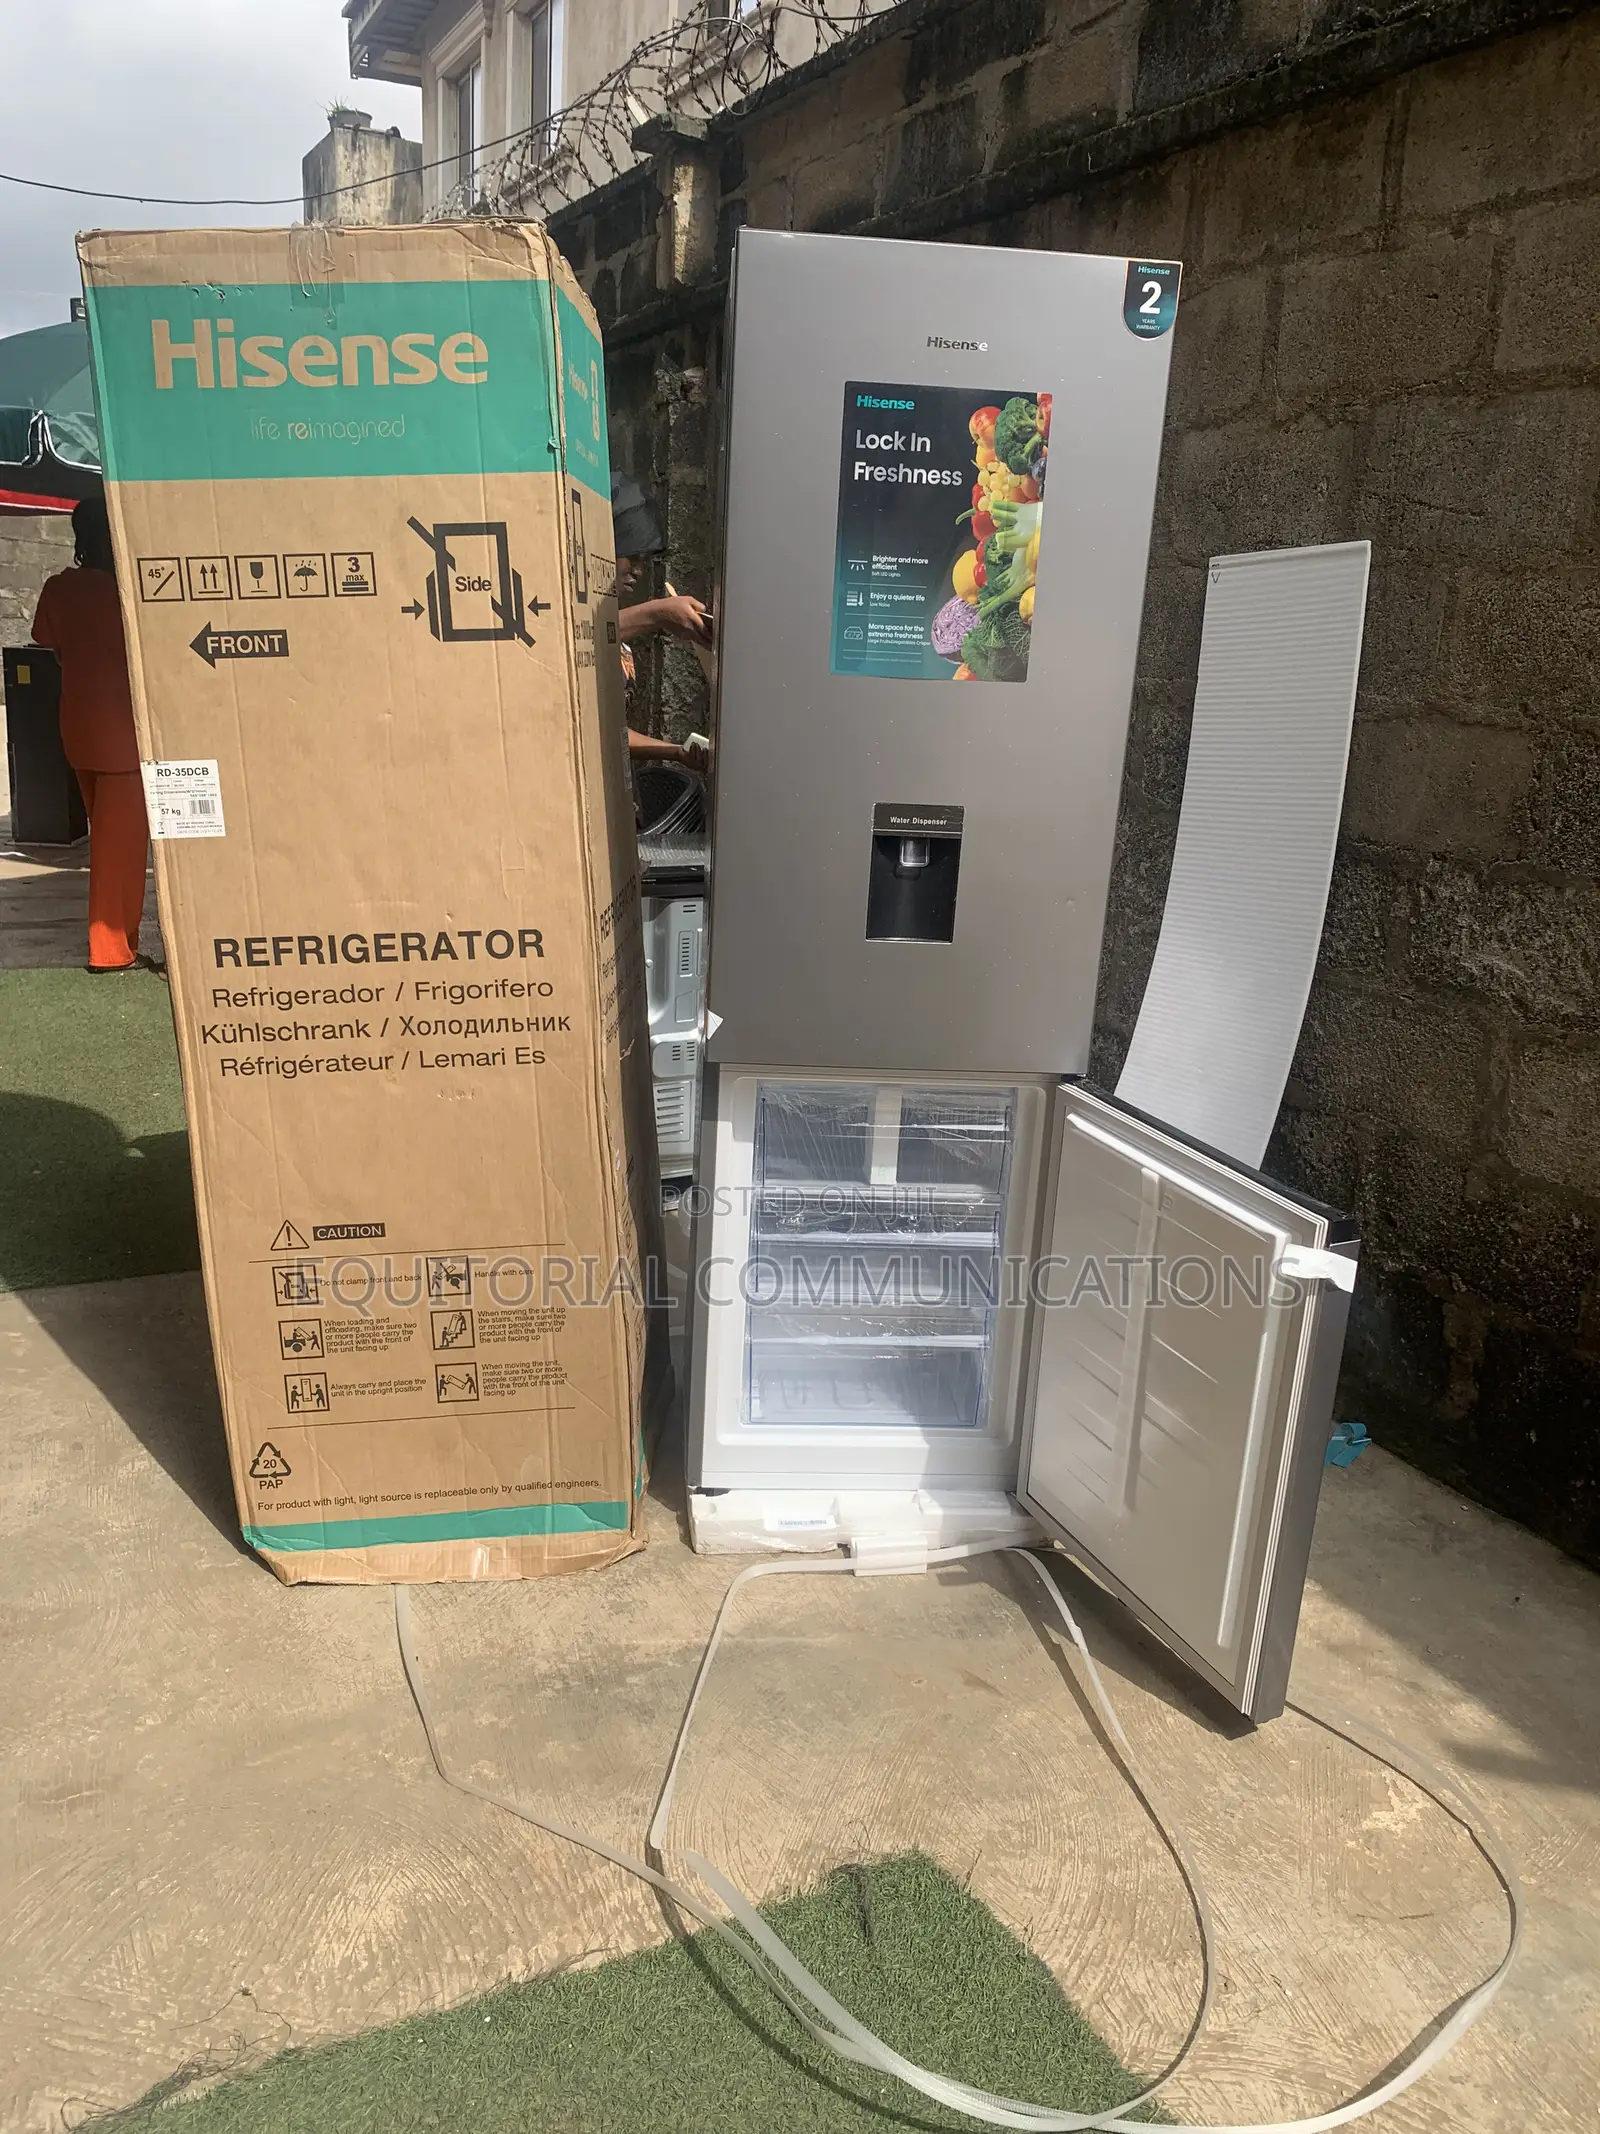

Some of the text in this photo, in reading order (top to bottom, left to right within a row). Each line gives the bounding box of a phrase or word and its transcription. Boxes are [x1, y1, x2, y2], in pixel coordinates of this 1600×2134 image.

[1138, 266, 1170, 275] Hisense
[1140, 281, 1162, 314] 2
[926, 336, 989, 351] Hisense
[151, 317, 489, 390] Hisense
[856, 395, 915, 410] Hisense
[250, 414, 405, 445] life reimagined
[856, 430, 931, 452] Lock In
[854, 462, 963, 486] Freshness
[348, 556, 361, 573] 3
[872, 555, 898, 563] Brighter
[346, 574, 365, 582] max
[456, 576, 492, 594] Side
[870, 592, 888, 601] Enjoy
[892, 594, 915, 602] quieter
[206, 634, 283, 654] FRONT
[157, 767, 210, 777] RD-35DCB
[172, 808, 181, 816] kg
[890, 816, 948, 826] Water Dispenser
[213, 928, 545, 969] REFRIGERATOR
[212, 983, 385, 1012] Refrigerador
[414, 978, 554, 1007] Frigorifero
[201, 1018, 372, 1045] Kühlschrank
[400, 1013, 571, 1040] Холодильник
[220, 1052, 394, 1079] Réfrigérateur
[419, 1048, 507, 1069] Lemari
[515, 1046, 546, 1065] Es
[316, 1225, 382, 1240] CAUTION
[502, 1268, 518, 1276] with
[346, 1277, 368, 1286] clamp
[369, 1276, 387, 1284] front
[388, 1275, 403, 1283] and
[404, 1274, 422, 1282] back
[501, 1308, 527, 1316] moving
[542, 1306, 555, 1314] unit
[348, 1318, 374, 1327] loading
[508, 1322, 533, 1330] people
[534, 1320, 553, 1328] carry
[356, 1331, 380, 1340] people
[480, 1330, 507, 1338] product
[508, 1328, 523, 1336] with
[326, 1340, 354, 1348] product
[508, 1335, 530, 1343] facing
[327, 1346, 339, 1354] the
[356, 1344, 378, 1353] facing
[504, 1361, 531, 1369] moving
[483, 1376, 507, 1384] people
[542, 1372, 568, 1381] product
[330, 1383, 356, 1391] Always
[394, 1379, 413, 1387] place
[368, 1387, 393, 1396] upright
[394, 1385, 423, 1394] position
[484, 1389, 505, 1397] facing
[263, 1459, 277, 1469] 20
[260, 1479, 284, 1490] PAP
[258, 1479, 602, 1513] For product with light, light source is replaceable only by qualified engineers.
